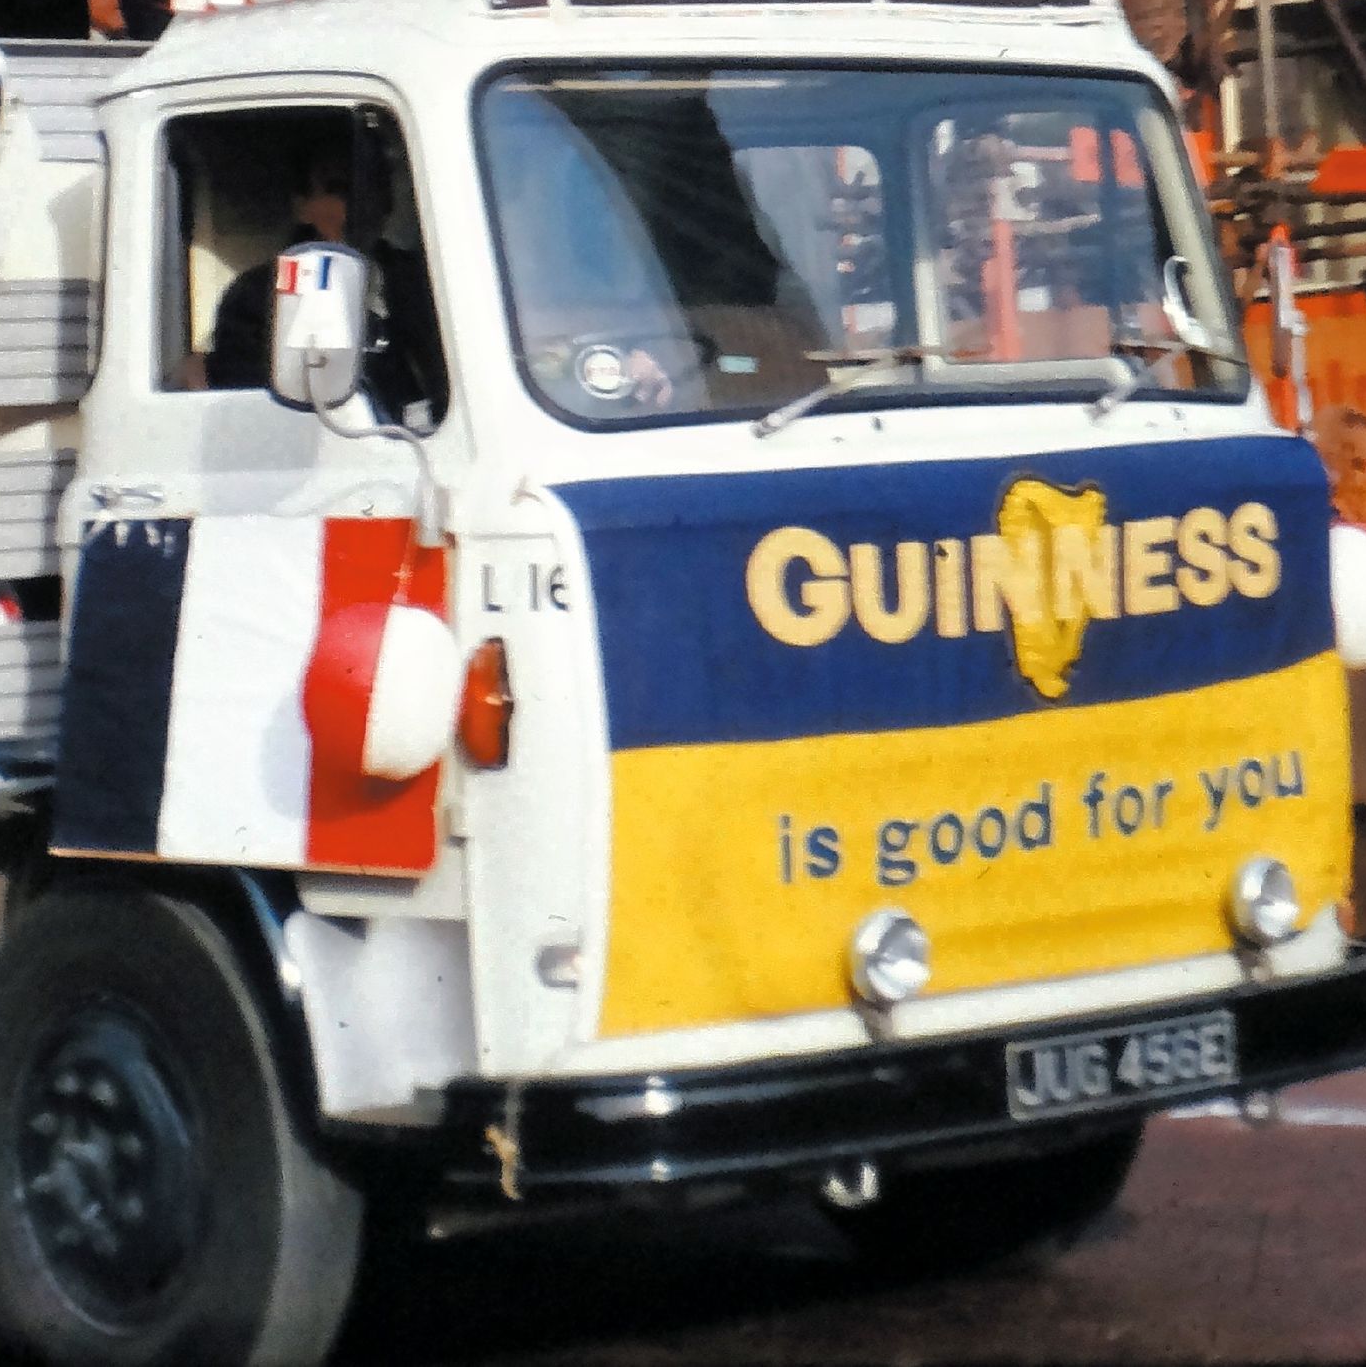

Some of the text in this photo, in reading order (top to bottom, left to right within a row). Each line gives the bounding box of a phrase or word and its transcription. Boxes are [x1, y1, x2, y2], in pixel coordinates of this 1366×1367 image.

[745, 501, 1283, 647] GUINNESS
[776, 749, 1306, 887] is good for you
[1015, 1043, 1112, 1106] JUG
